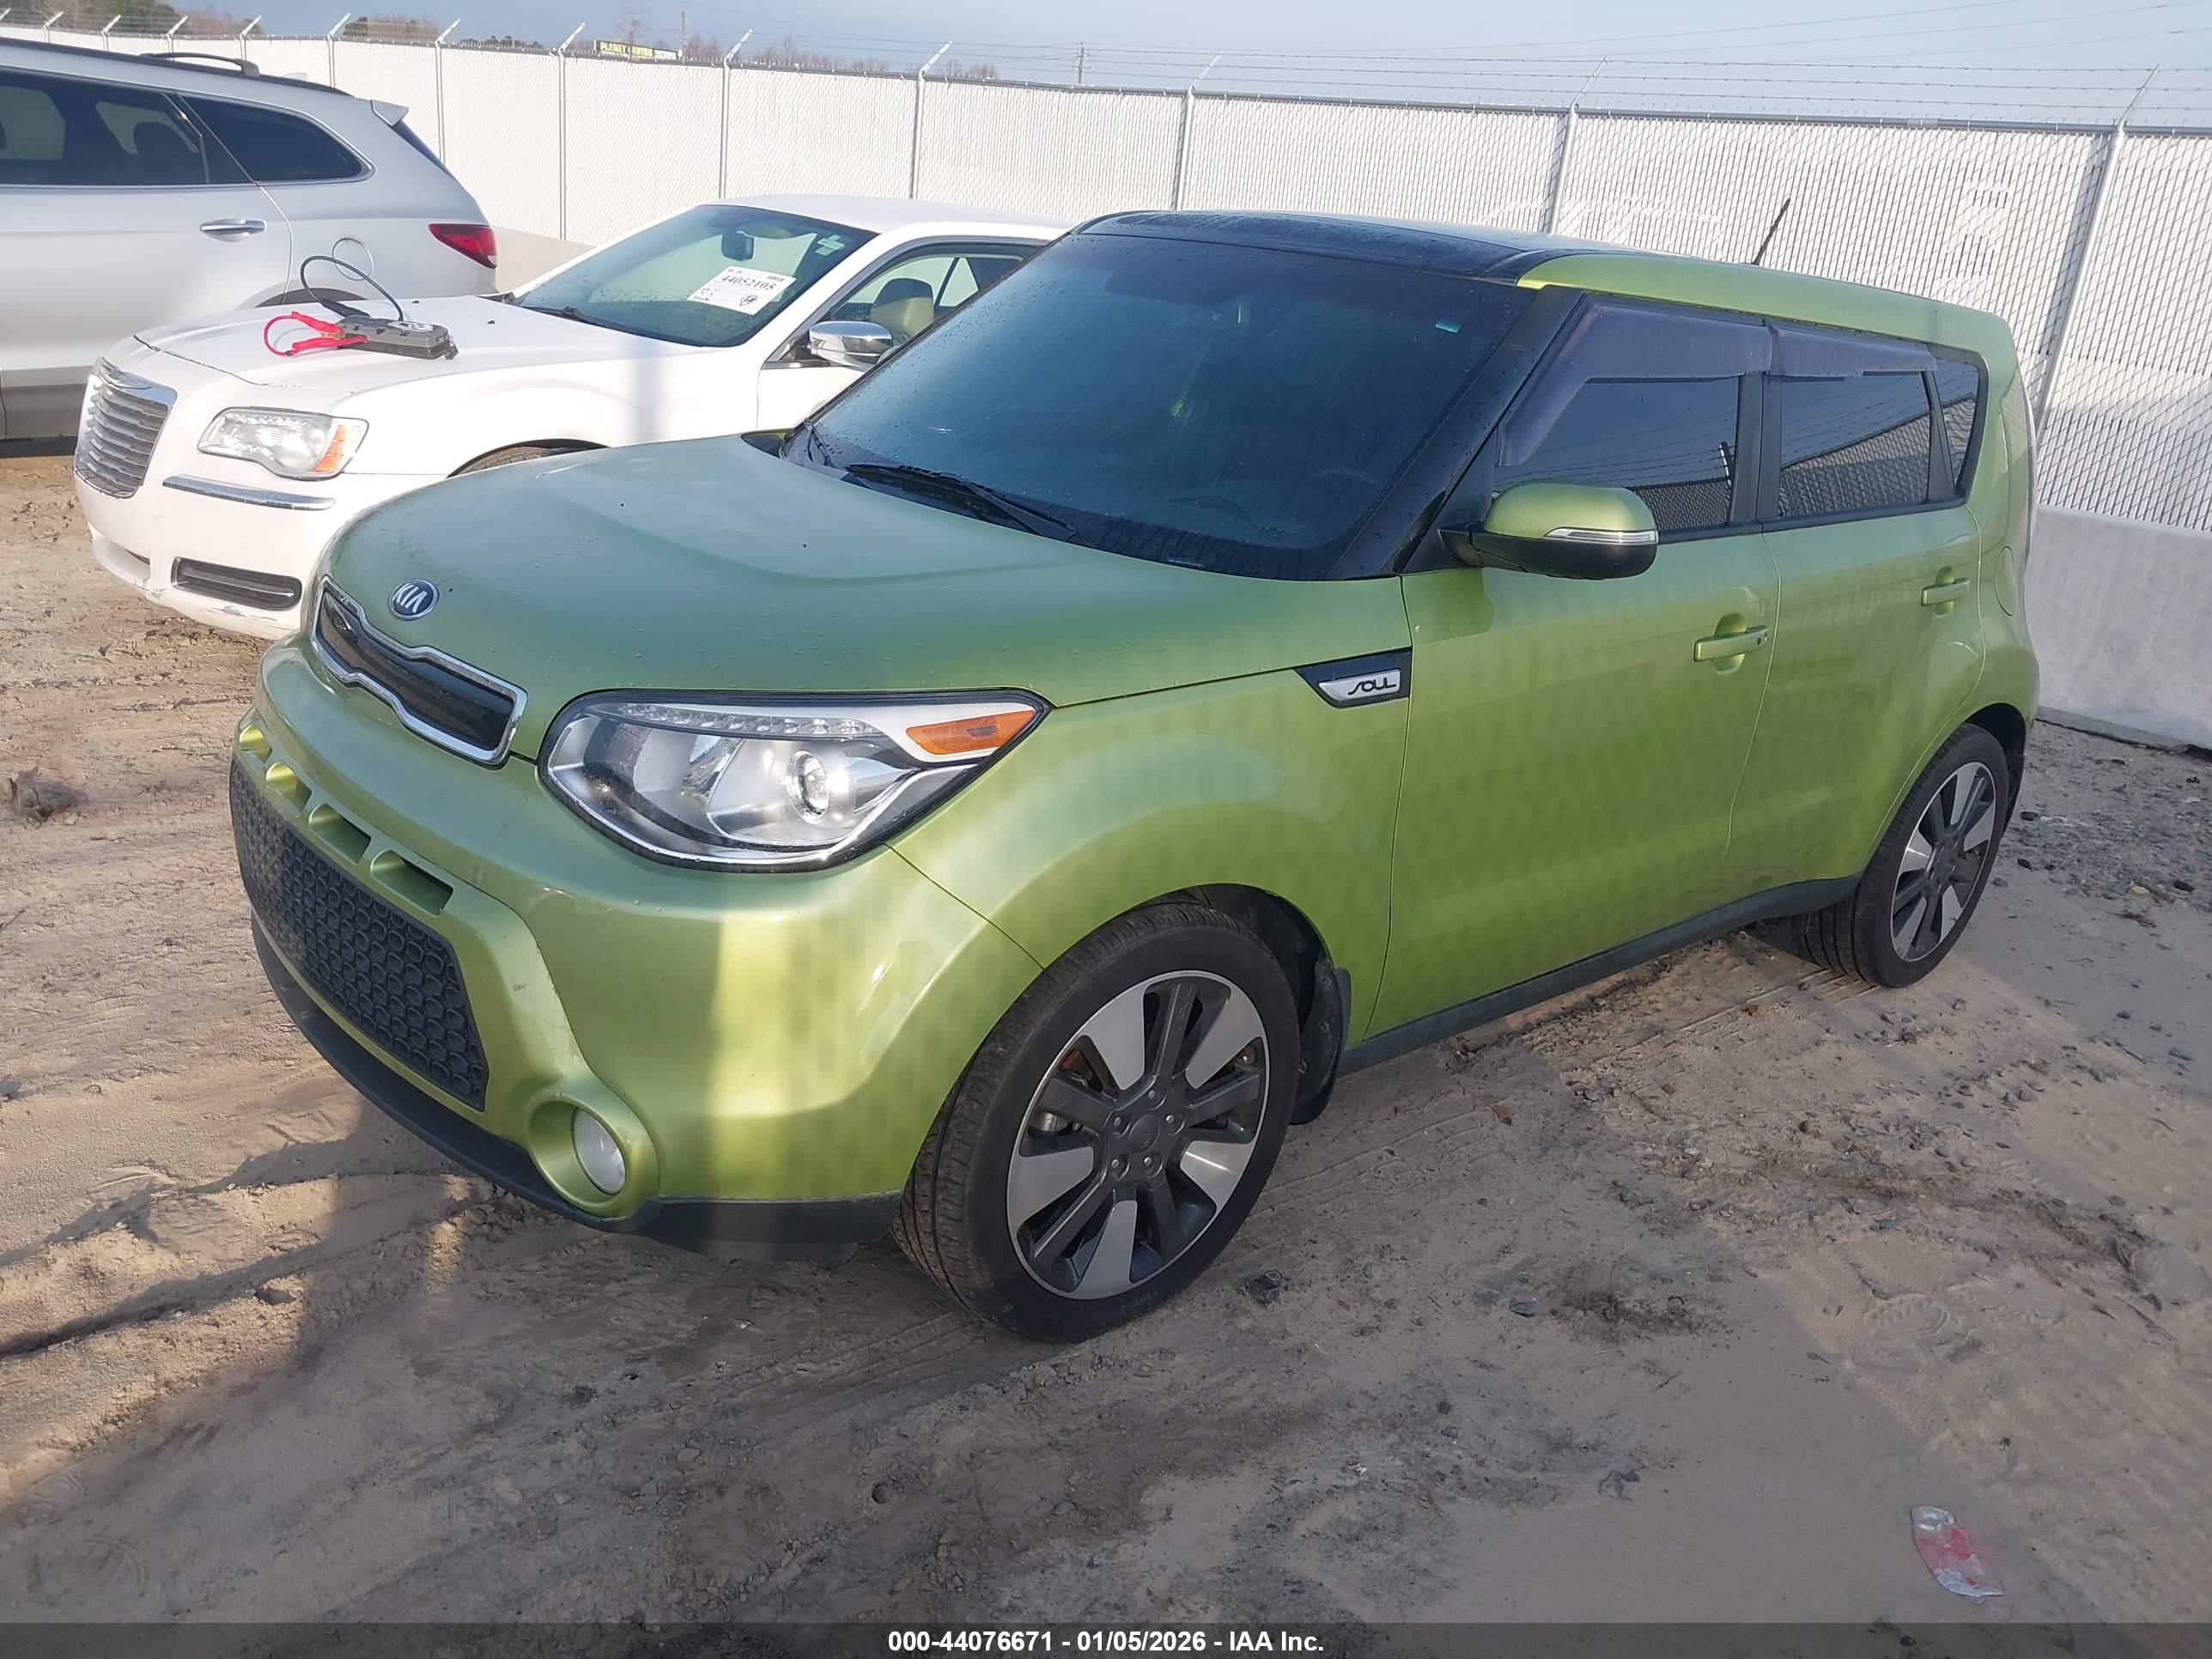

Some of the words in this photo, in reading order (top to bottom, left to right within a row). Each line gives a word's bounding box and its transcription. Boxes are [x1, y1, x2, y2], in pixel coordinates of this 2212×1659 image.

[721, 275, 776, 290] 44052105
[392, 582, 428, 613] KIA
[1347, 677, 1397, 696] SOUL
